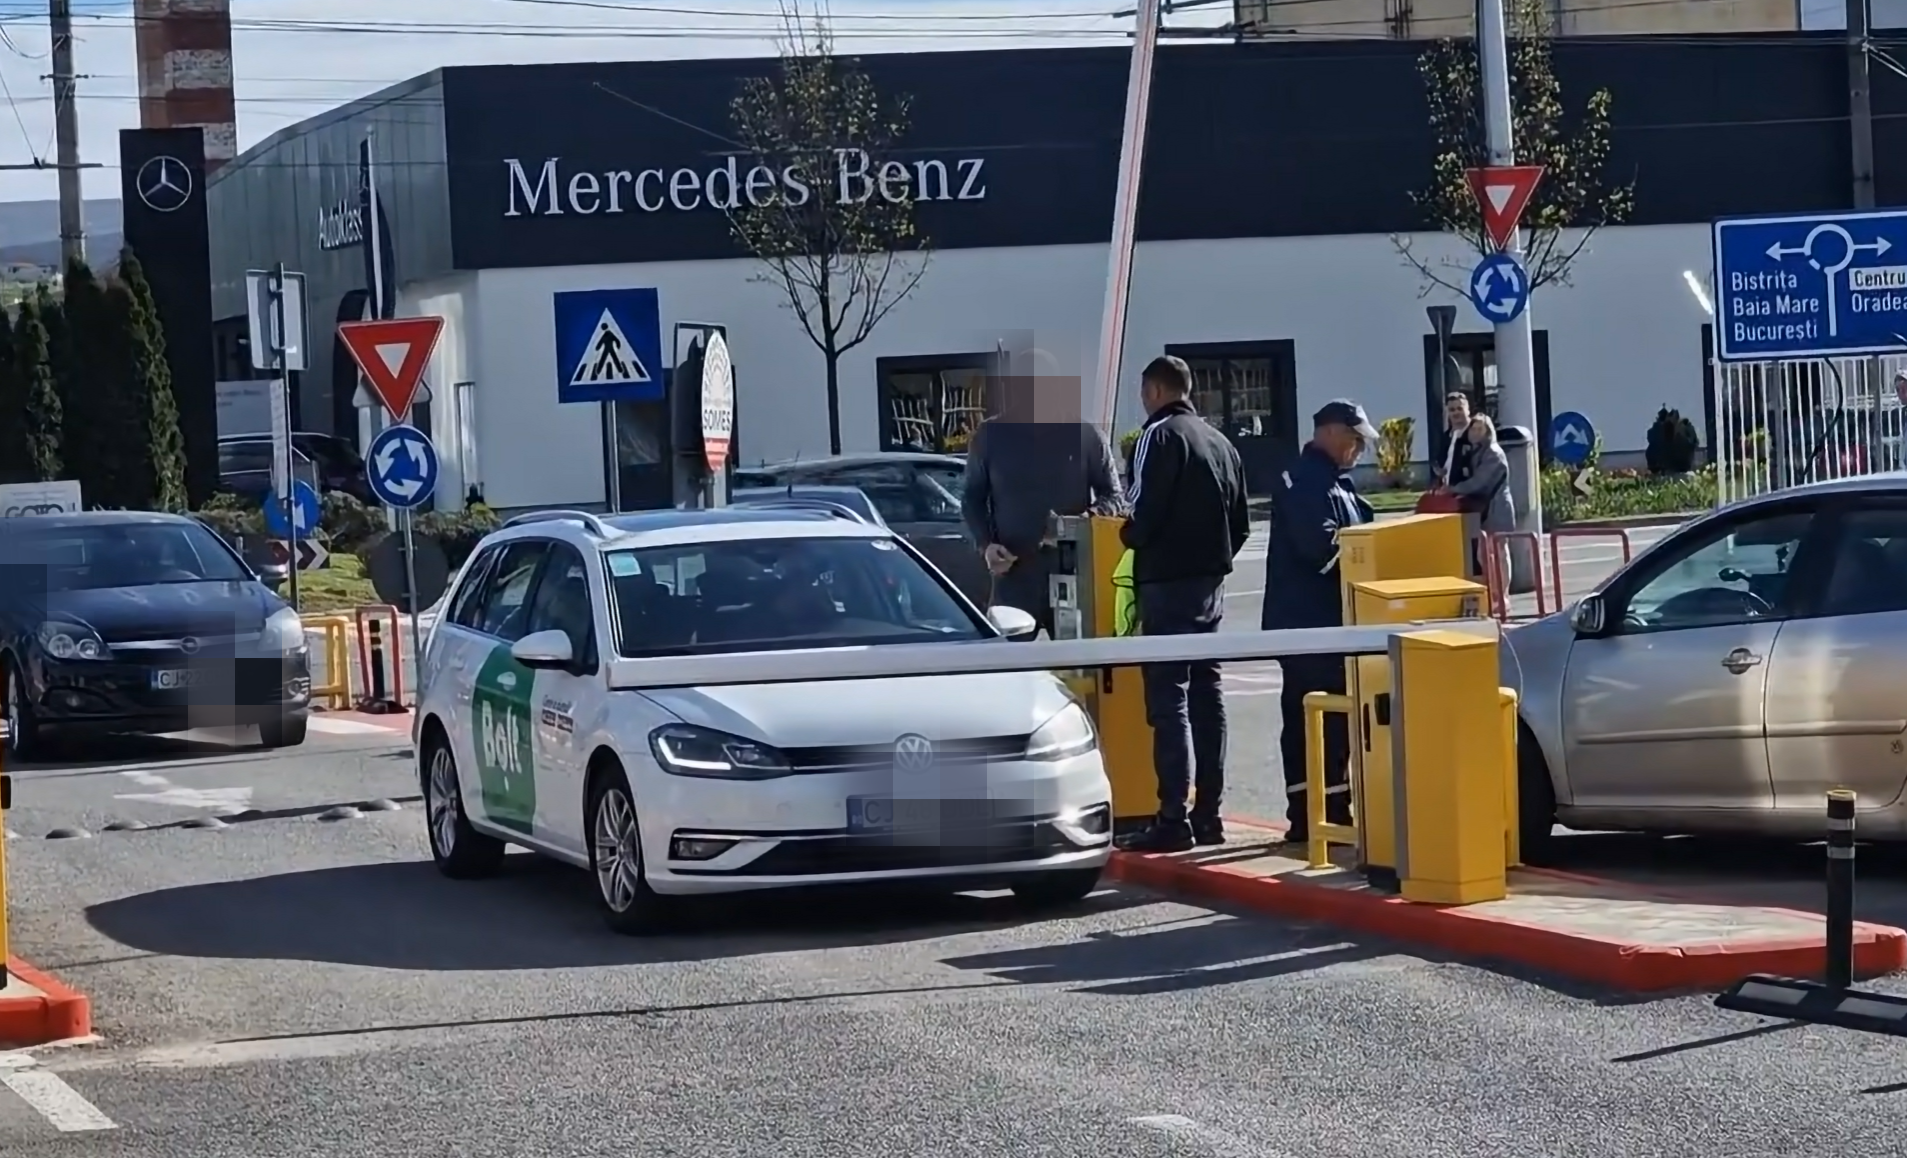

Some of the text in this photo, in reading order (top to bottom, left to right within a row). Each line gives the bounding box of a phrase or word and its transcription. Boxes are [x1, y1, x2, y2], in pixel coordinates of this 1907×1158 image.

[504, 147, 986, 216] Mercedes Benz
[1854, 269, 1906, 288] Centru
[1733, 294, 1819, 317] Baia Mare
[482, 700, 522, 774] Bolt
